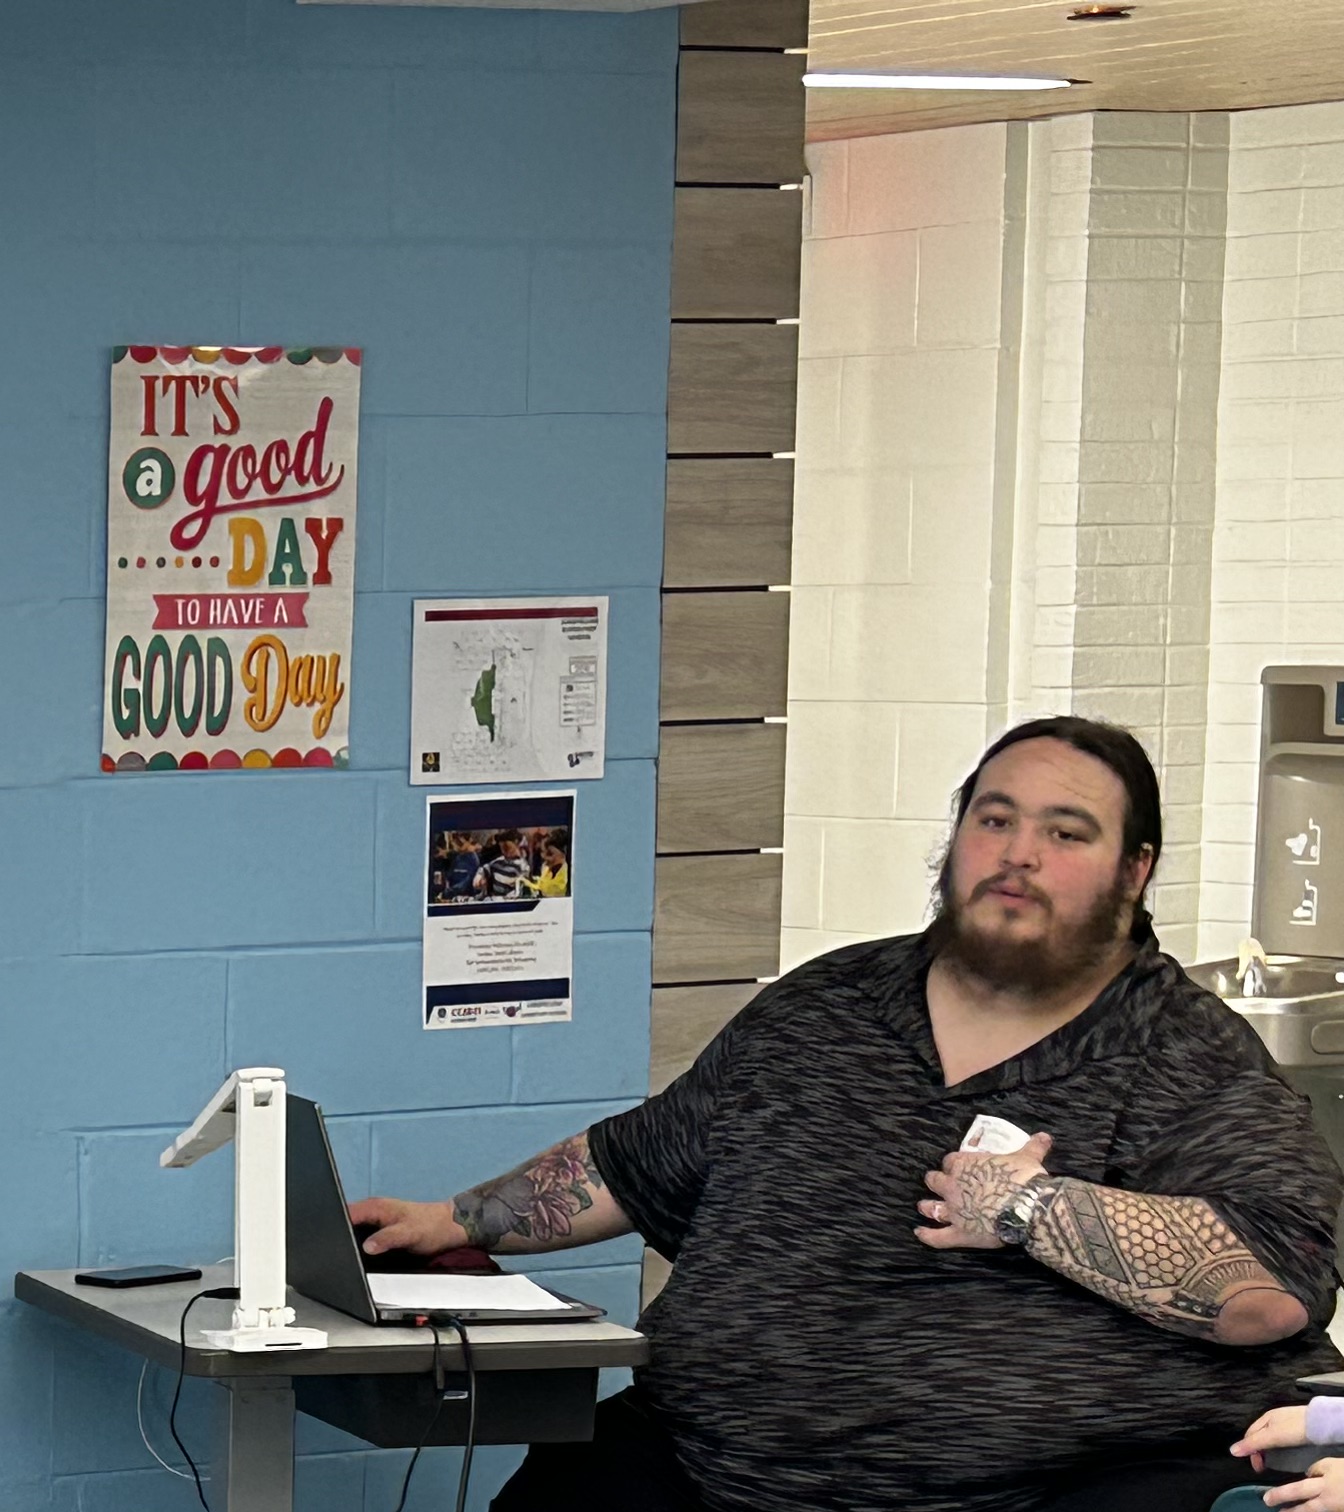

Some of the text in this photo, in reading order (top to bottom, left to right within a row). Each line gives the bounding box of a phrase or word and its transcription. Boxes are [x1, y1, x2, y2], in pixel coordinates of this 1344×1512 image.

[139, 375, 241, 437] IT'S
[134, 396, 345, 551] a good
[226, 517, 344, 587] DAY
[175, 597, 289, 625] TO HAVE A
[113, 634, 345, 740] GOOD Day
